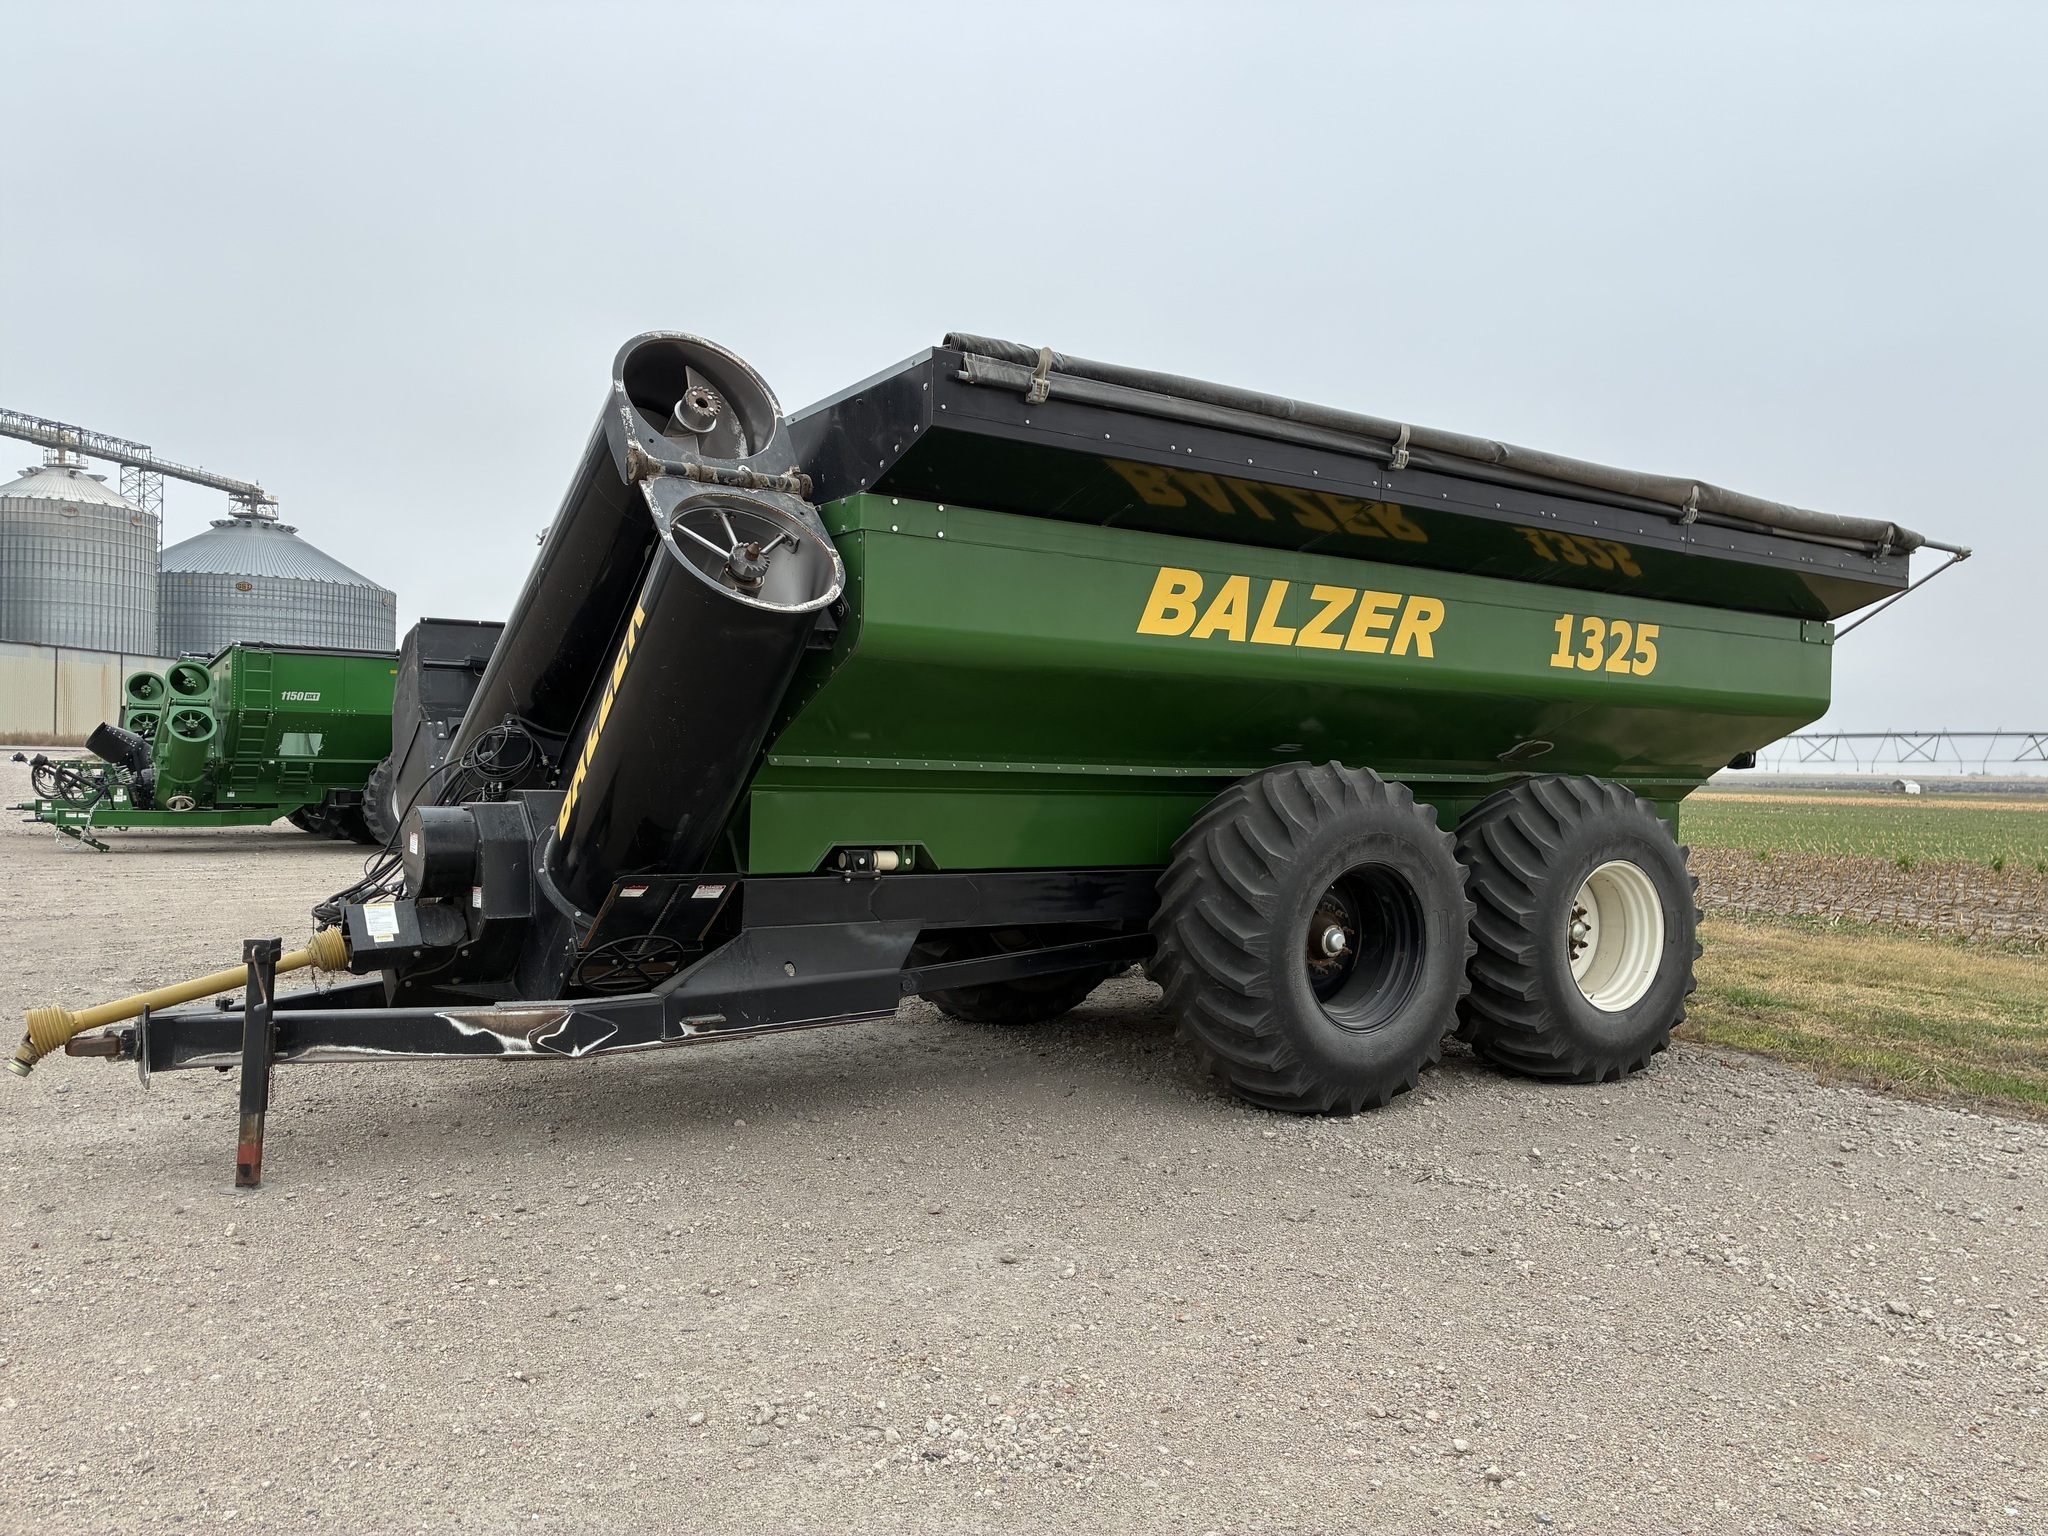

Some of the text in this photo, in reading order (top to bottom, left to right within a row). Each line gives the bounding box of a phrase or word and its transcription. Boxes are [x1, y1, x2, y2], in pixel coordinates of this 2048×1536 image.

[1136, 566, 1445, 659] BALZER
[1550, 613, 1660, 677] 1325
[281, 691, 305, 701] 1150
